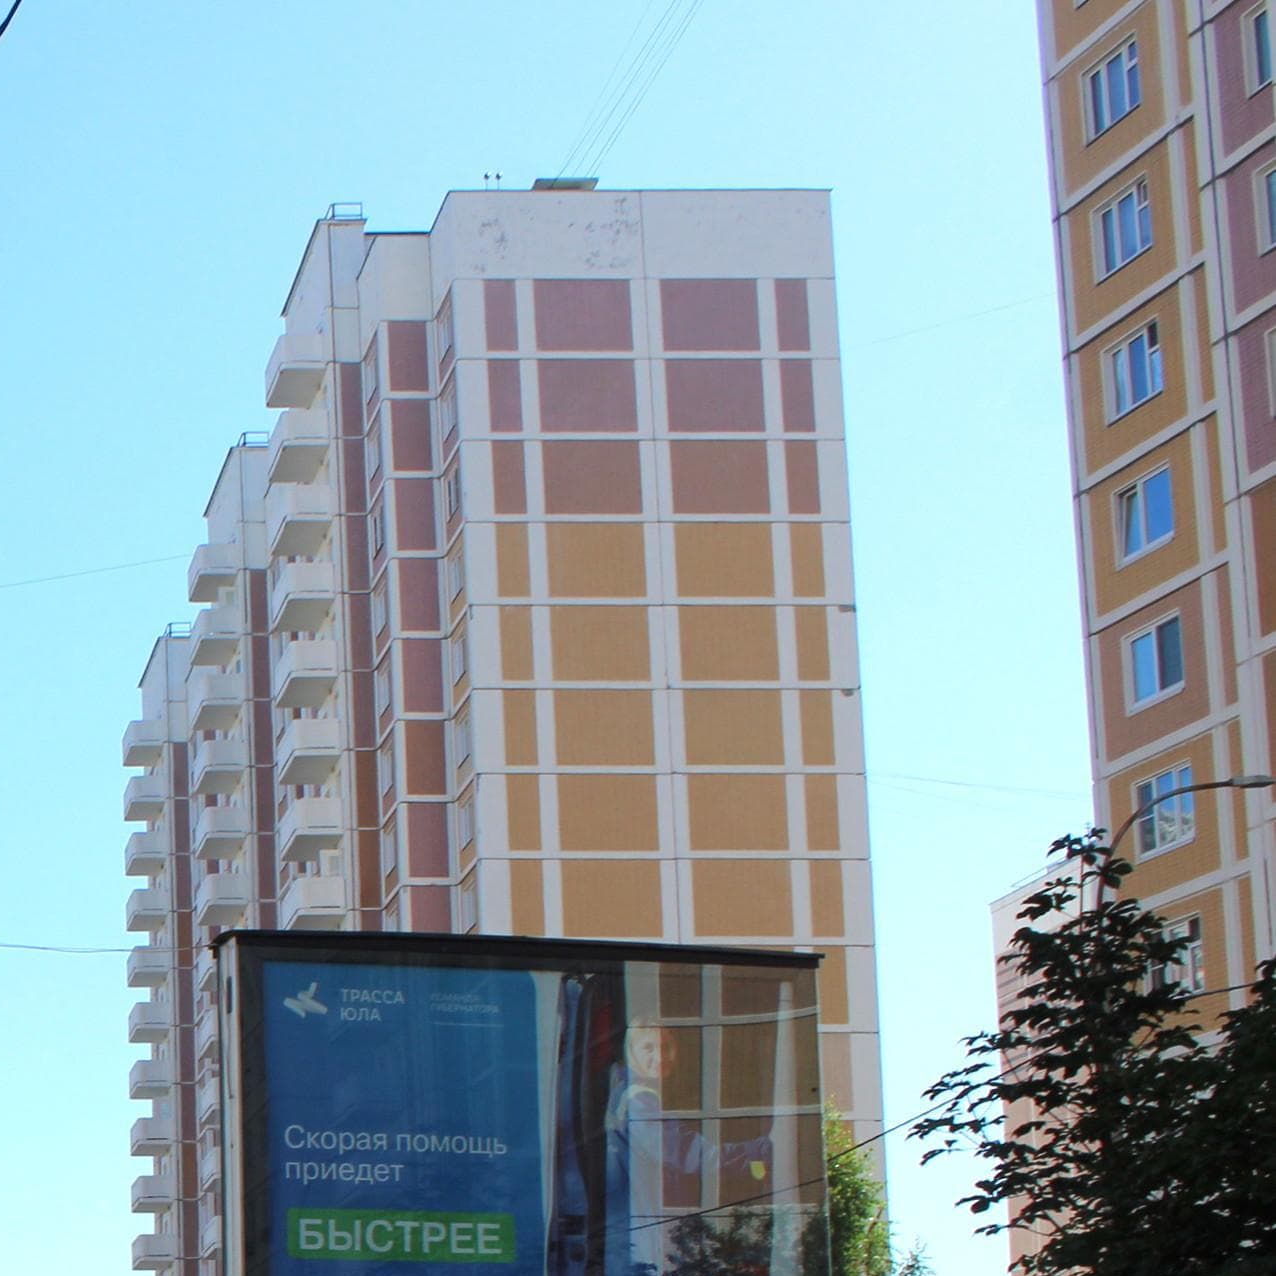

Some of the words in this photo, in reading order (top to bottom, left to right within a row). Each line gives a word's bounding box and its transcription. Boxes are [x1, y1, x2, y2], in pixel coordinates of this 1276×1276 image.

[340, 988, 405, 1005] ТРАССА
[340, 1007, 382, 1022] ЮЛА
[284, 1124, 388, 1155] Скорая
[397, 1133, 508, 1159] помощь
[285, 1161, 405, 1185] приедет
[298, 1218, 503, 1255] БЫСТРЕЕ
